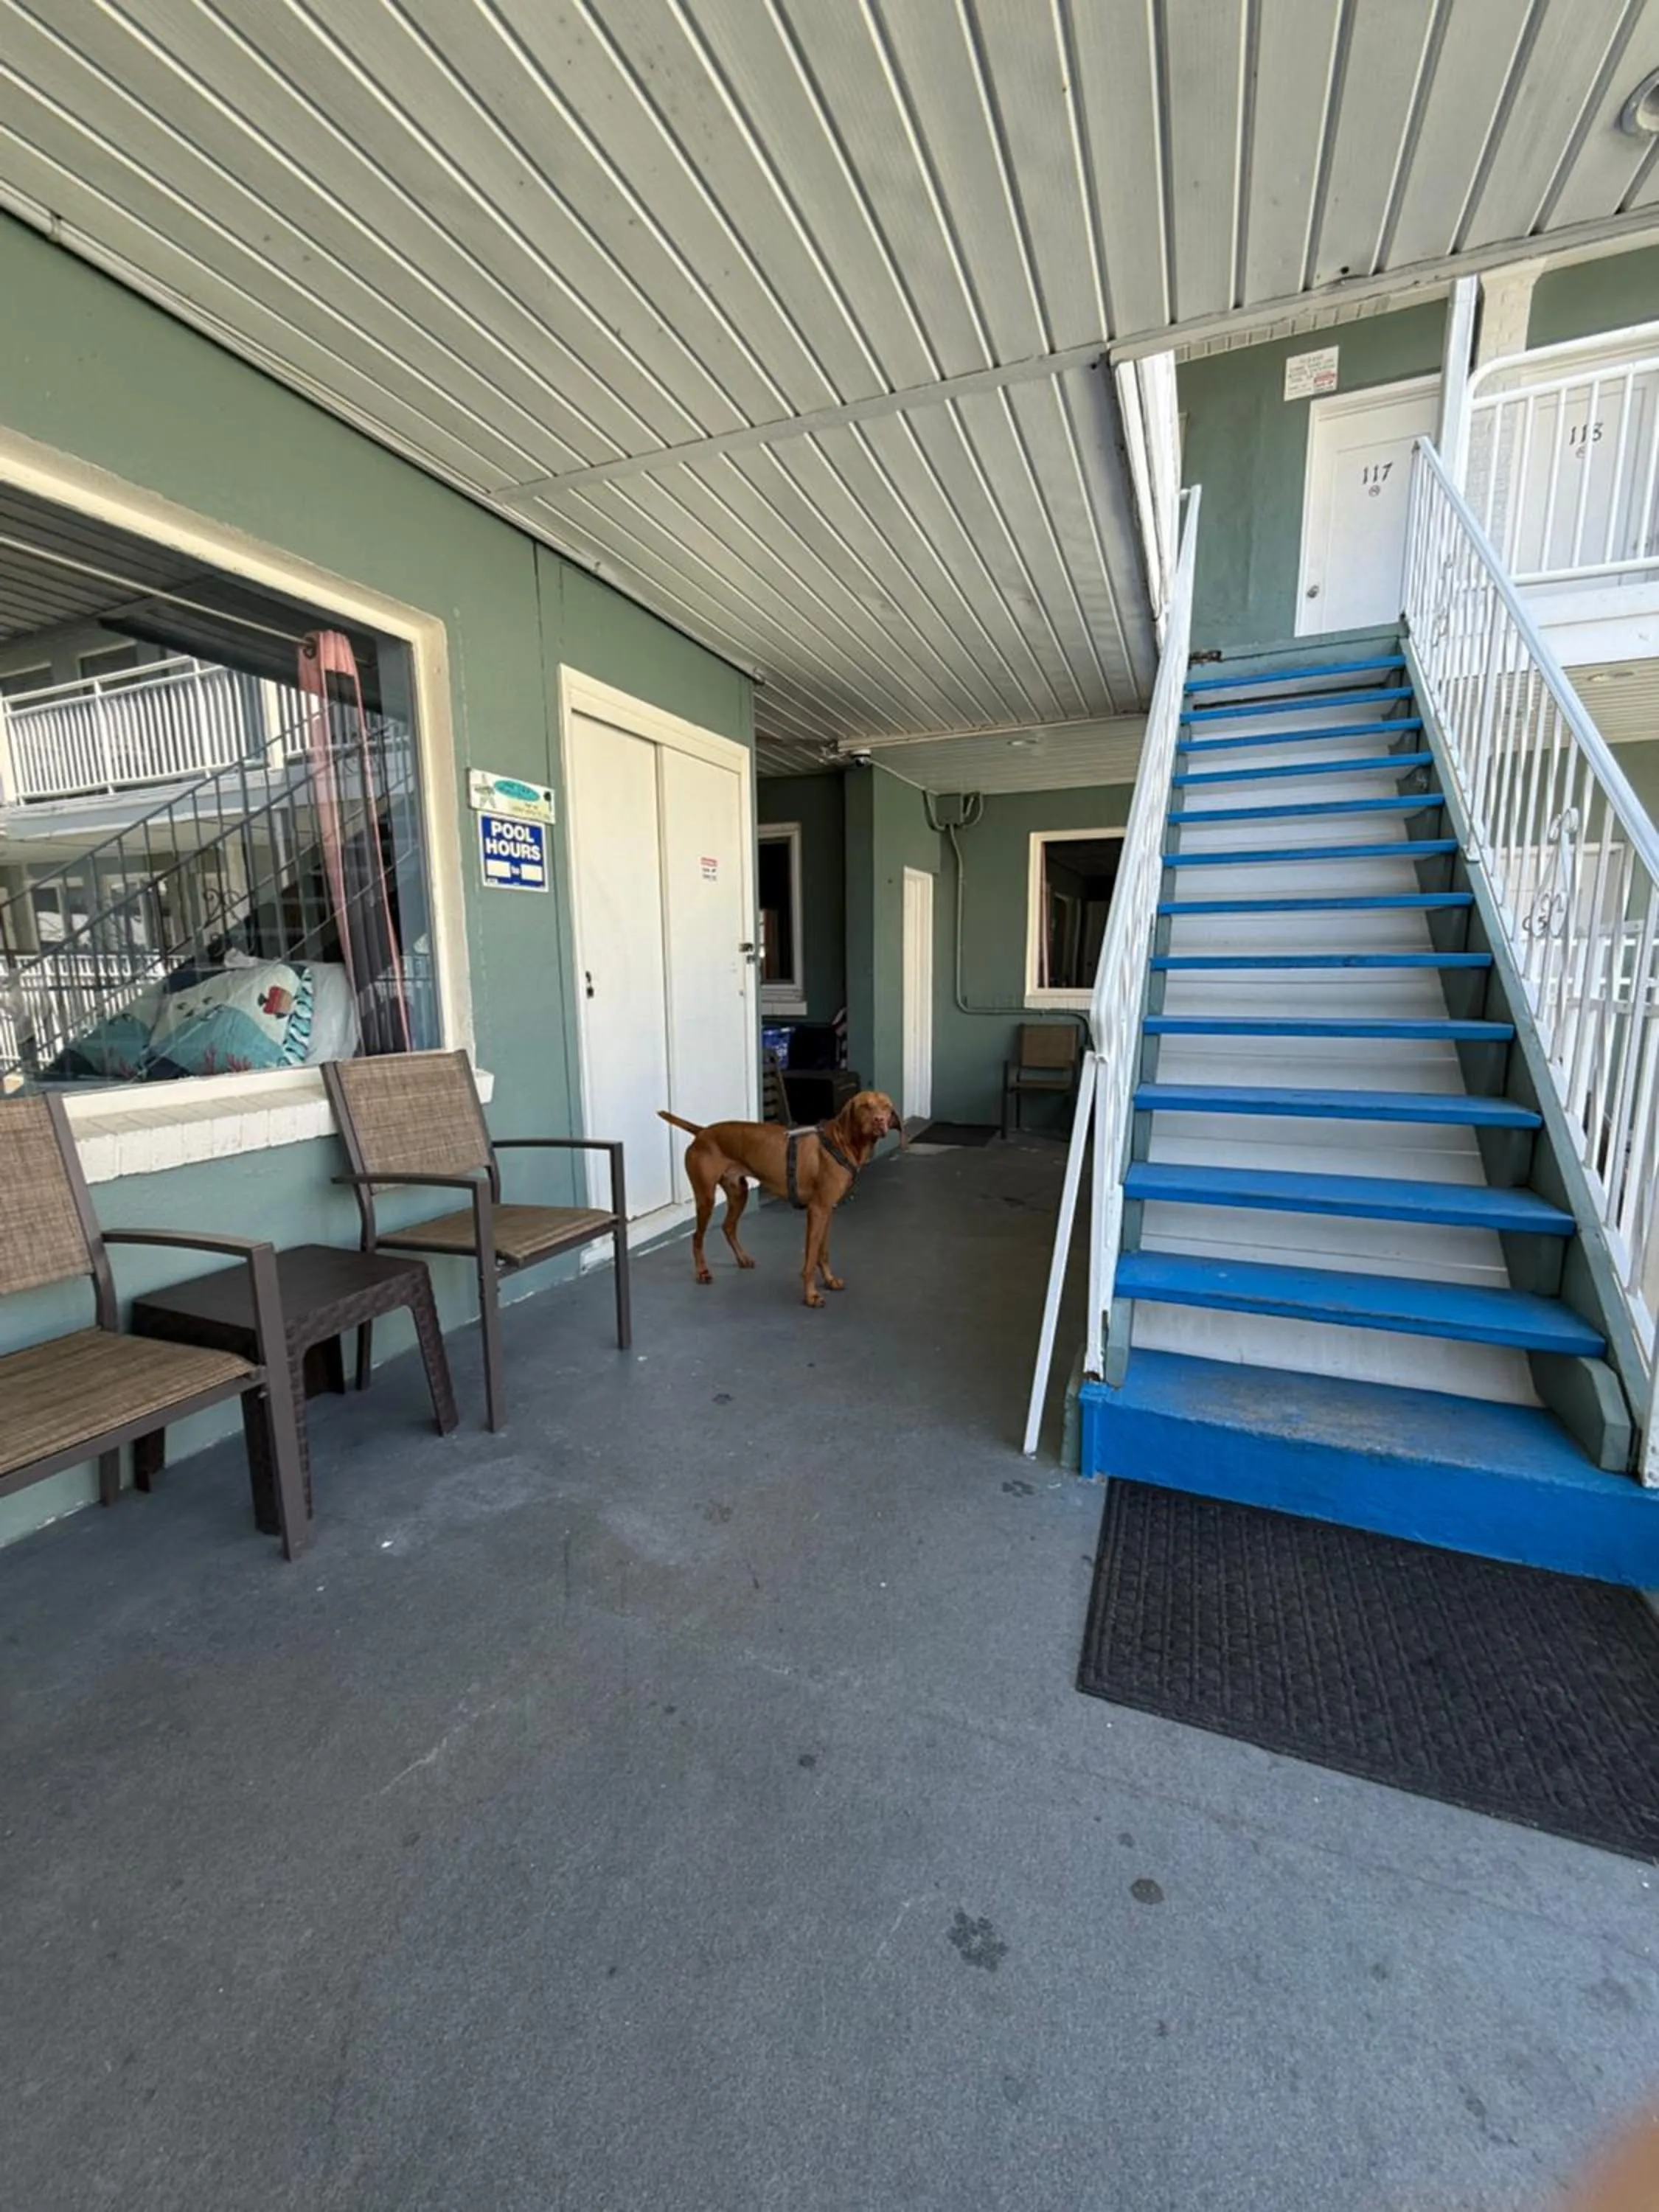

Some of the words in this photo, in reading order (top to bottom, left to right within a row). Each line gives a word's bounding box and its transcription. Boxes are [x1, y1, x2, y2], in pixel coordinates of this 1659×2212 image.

[1363, 462, 1393, 484] 117
[491, 821, 535, 843] POOL
[485, 838, 541, 860] HOURS
